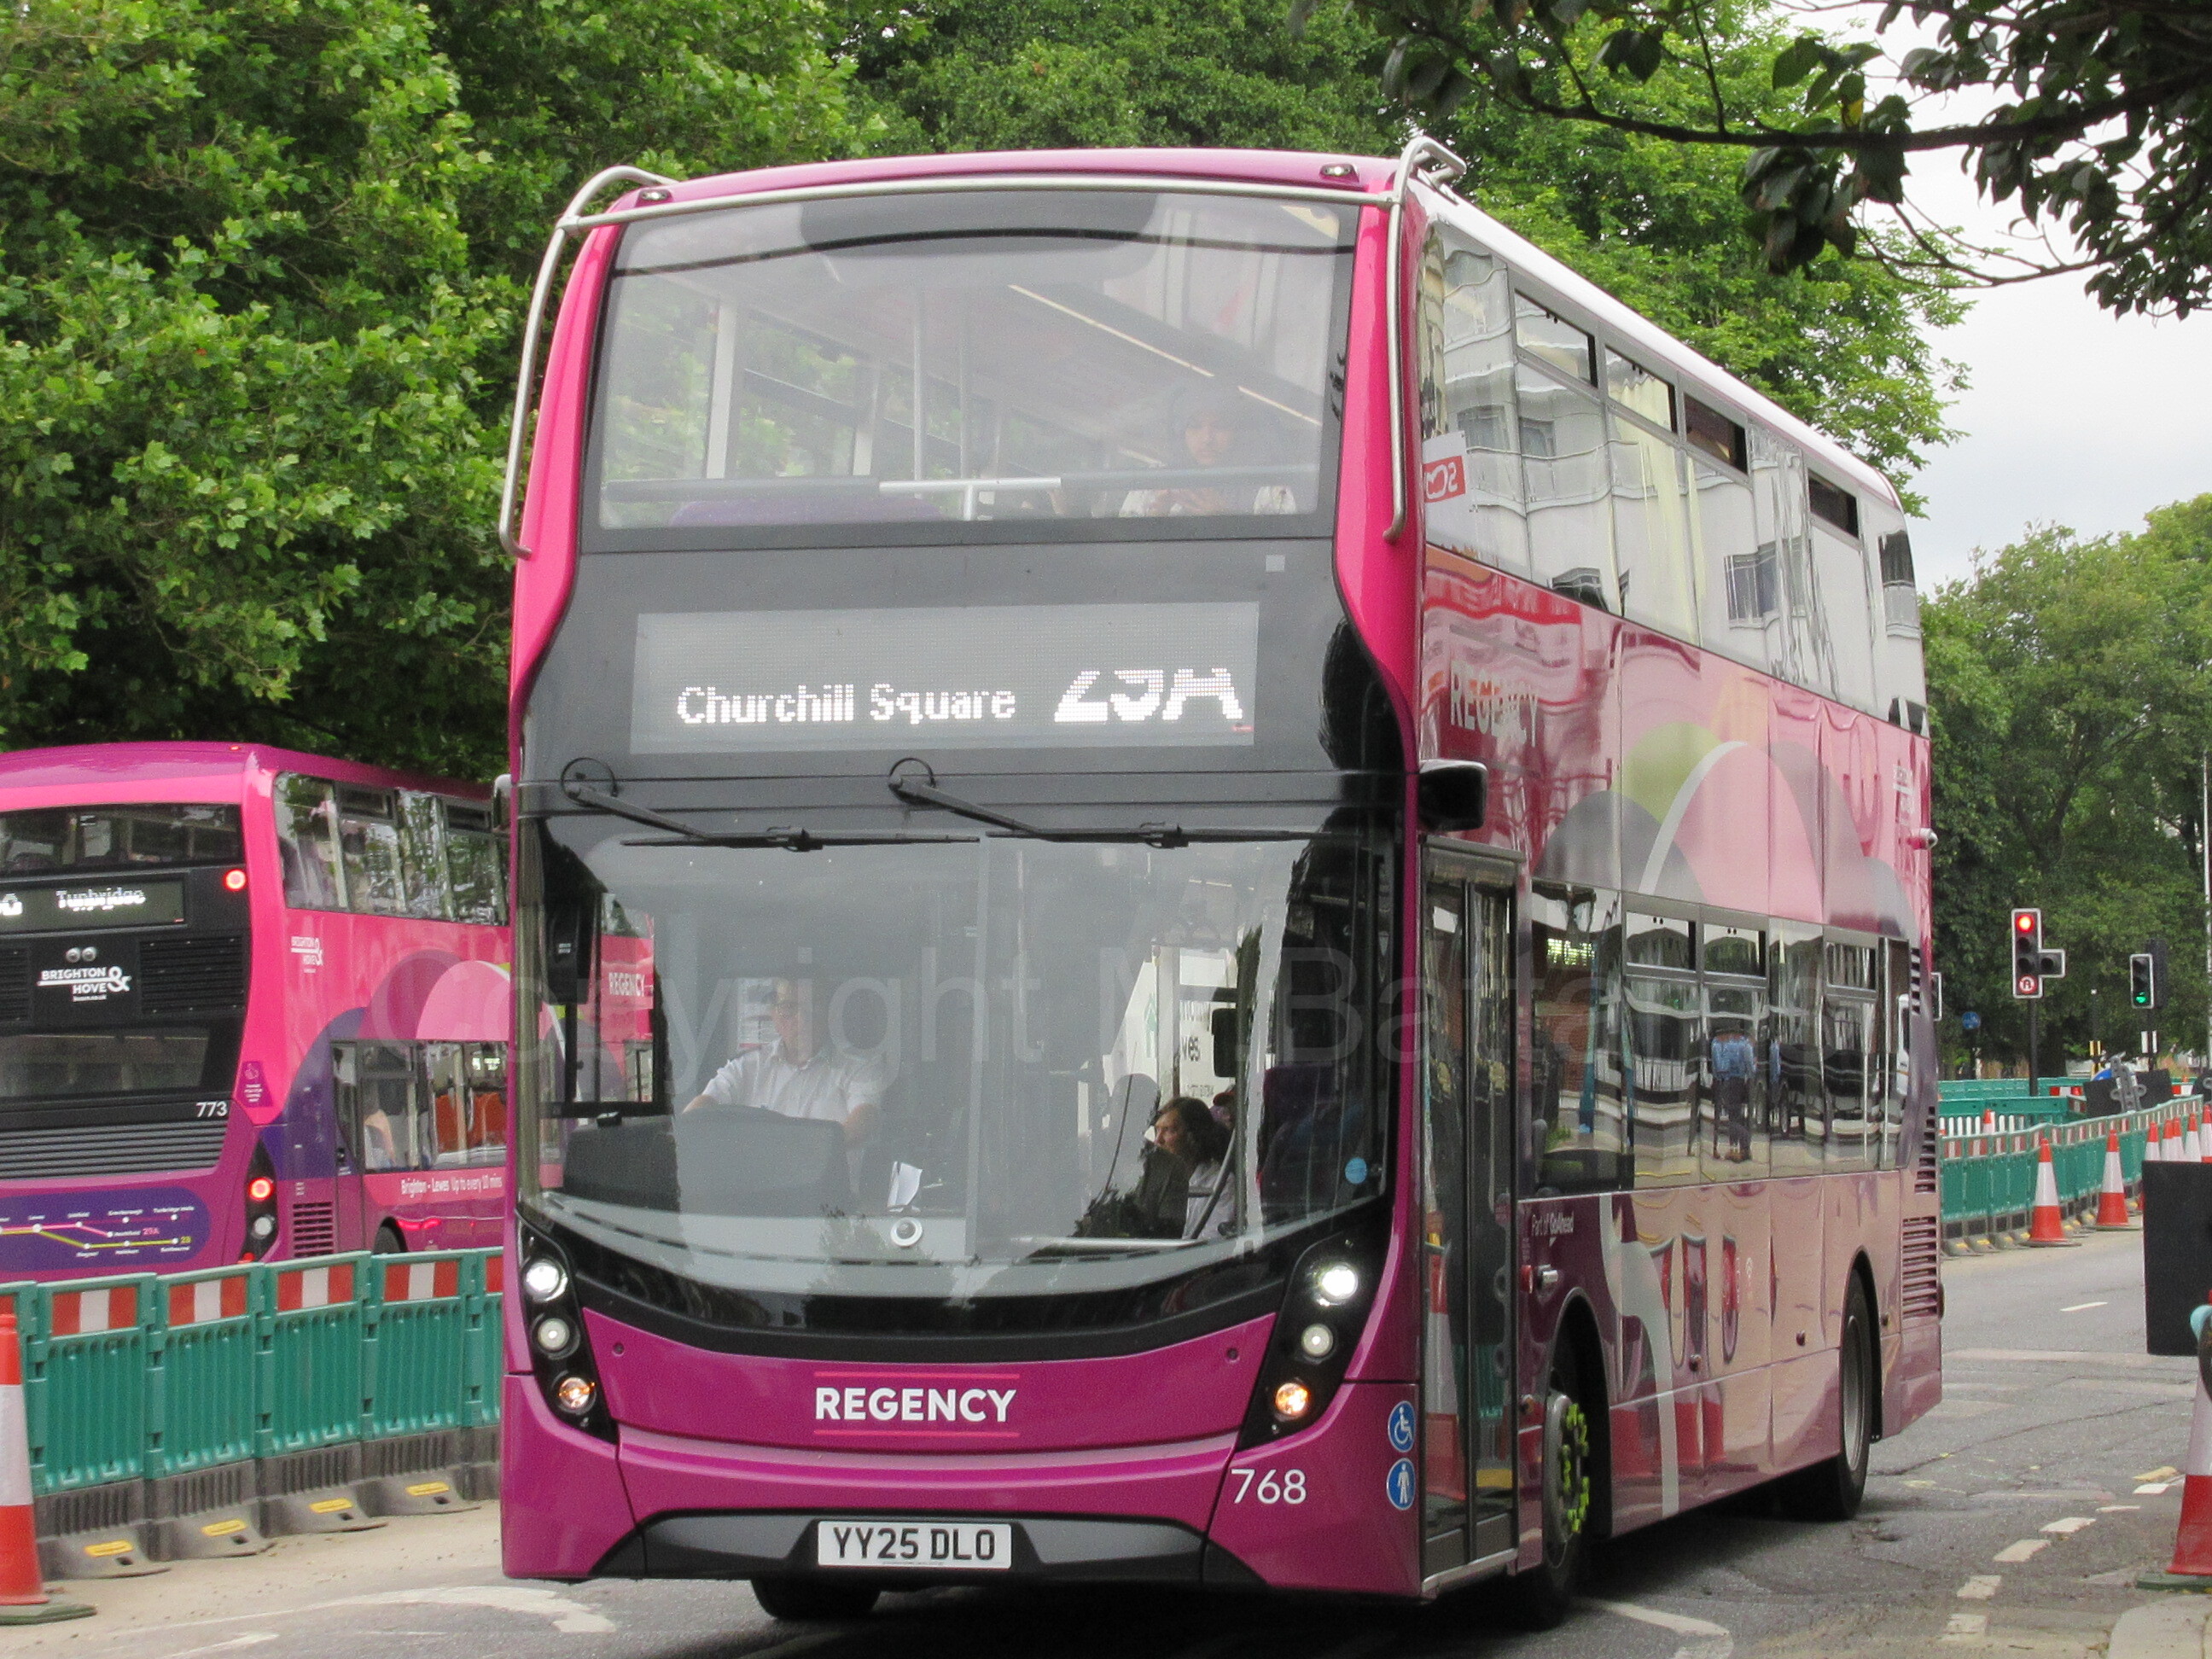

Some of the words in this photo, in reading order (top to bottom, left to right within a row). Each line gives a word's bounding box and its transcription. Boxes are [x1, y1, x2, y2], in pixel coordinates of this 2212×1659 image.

[677, 684, 854, 724] Churchill
[870, 683, 1016, 725] Square
[41, 966, 107, 981] BRIGHTON
[107, 966, 132, 992] &
[73, 982, 107, 995] HOVE
[608, 972, 645, 997] REGENCY
[195, 1101, 228, 1117] 773
[401, 1179, 427, 1198] Brighton
[815, 1387, 1017, 1423] REGENCY
[1231, 1468, 1307, 1505] 768
[833, 1527, 920, 1560] YY25
[930, 1528, 996, 1561] DLO
